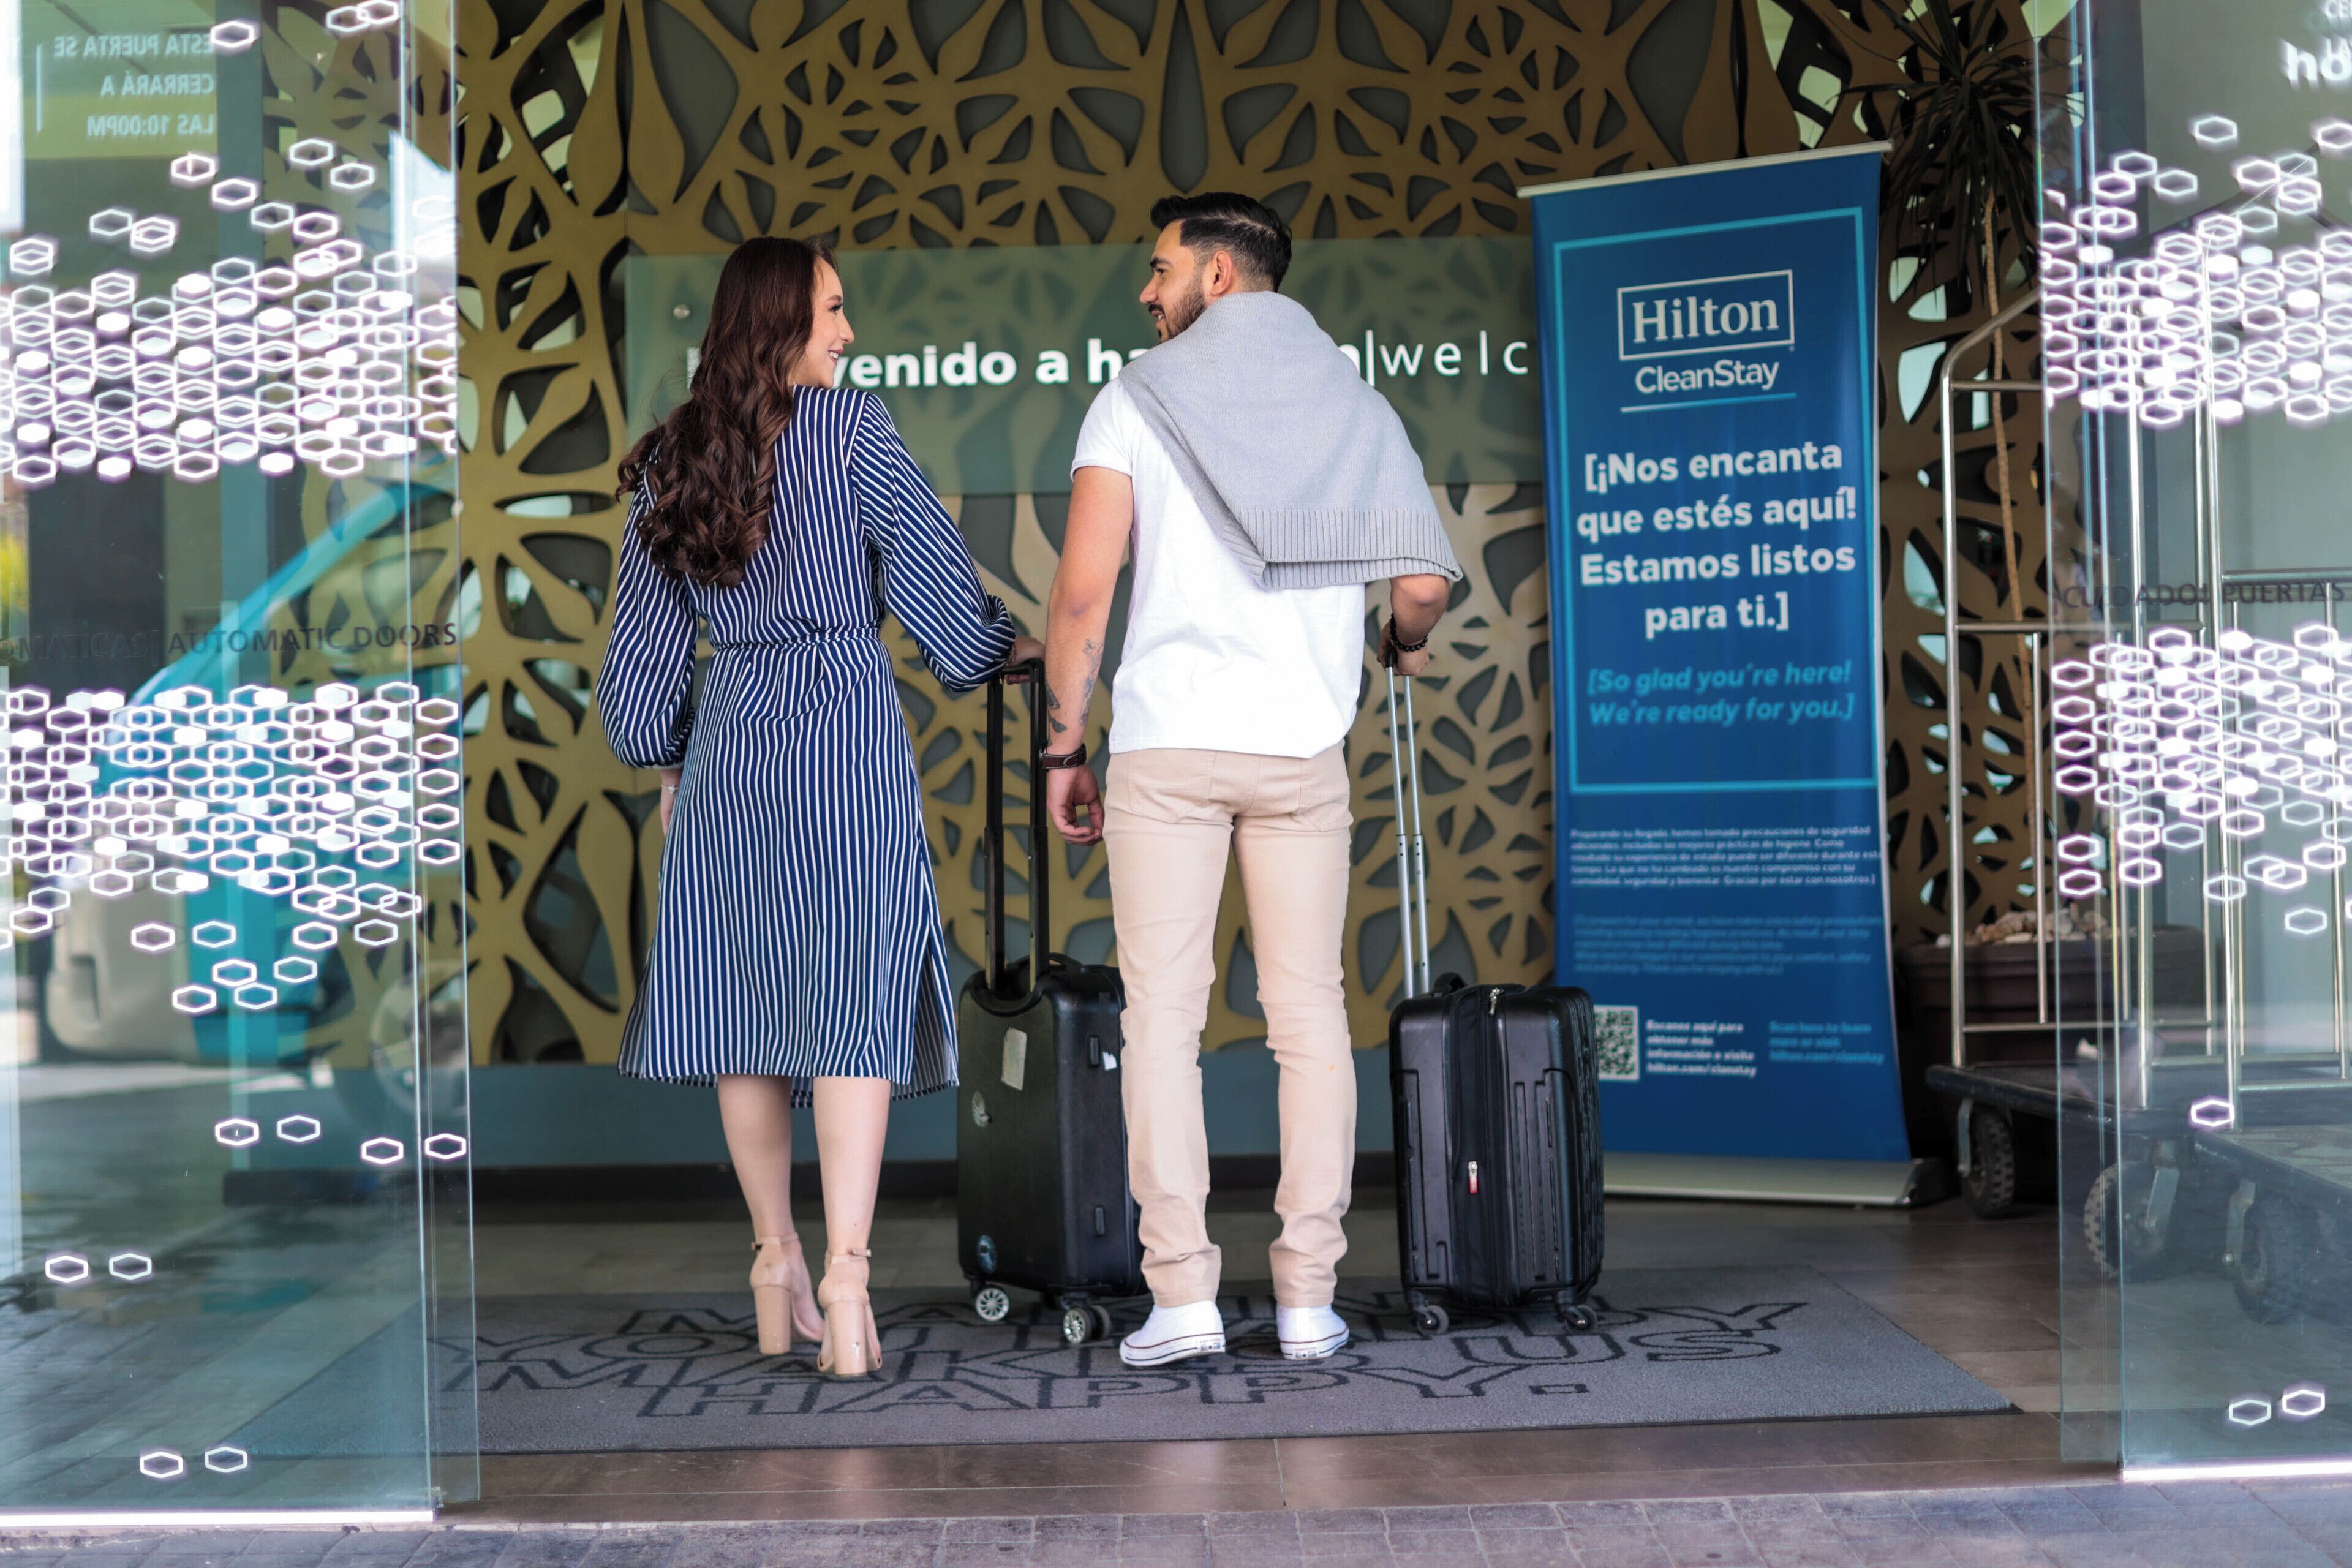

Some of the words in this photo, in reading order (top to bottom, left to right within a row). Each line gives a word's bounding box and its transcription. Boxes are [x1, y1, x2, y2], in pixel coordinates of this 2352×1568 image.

[1632, 296, 1779, 343] Hilton
[1036, 351, 1069, 385] a
[1635, 359, 1780, 394] CleanStay
[1585, 452, 1679, 494] [¡Nos
[1689, 441, 1842, 478] encanta
[1577, 509, 1644, 543] que
[1653, 494, 1752, 532] estés
[1763, 486, 1857, 530] aquí!
[1580, 553, 1740, 585] Estamos
[1751, 543, 1856, 576] listos
[2223, 580, 2345, 604] PUERTAS
[1645, 604, 1727, 639] para
[1737, 591, 1789, 630] ti.]
[168, 627, 343, 654] AUTOMATIC
[353, 622, 458, 648] DOORS
[1588, 668, 1630, 695] [So
[1635, 666, 1693, 697] glad
[1695, 662, 1777, 695] you're
[1785, 659, 1853, 685] here!
[1589, 698, 1660, 726] We're
[1665, 698, 1740, 727] ready
[1746, 697, 1784, 722] for
[1788, 692, 1855, 726] you.]
[1452, 1329, 1782, 1365] US
